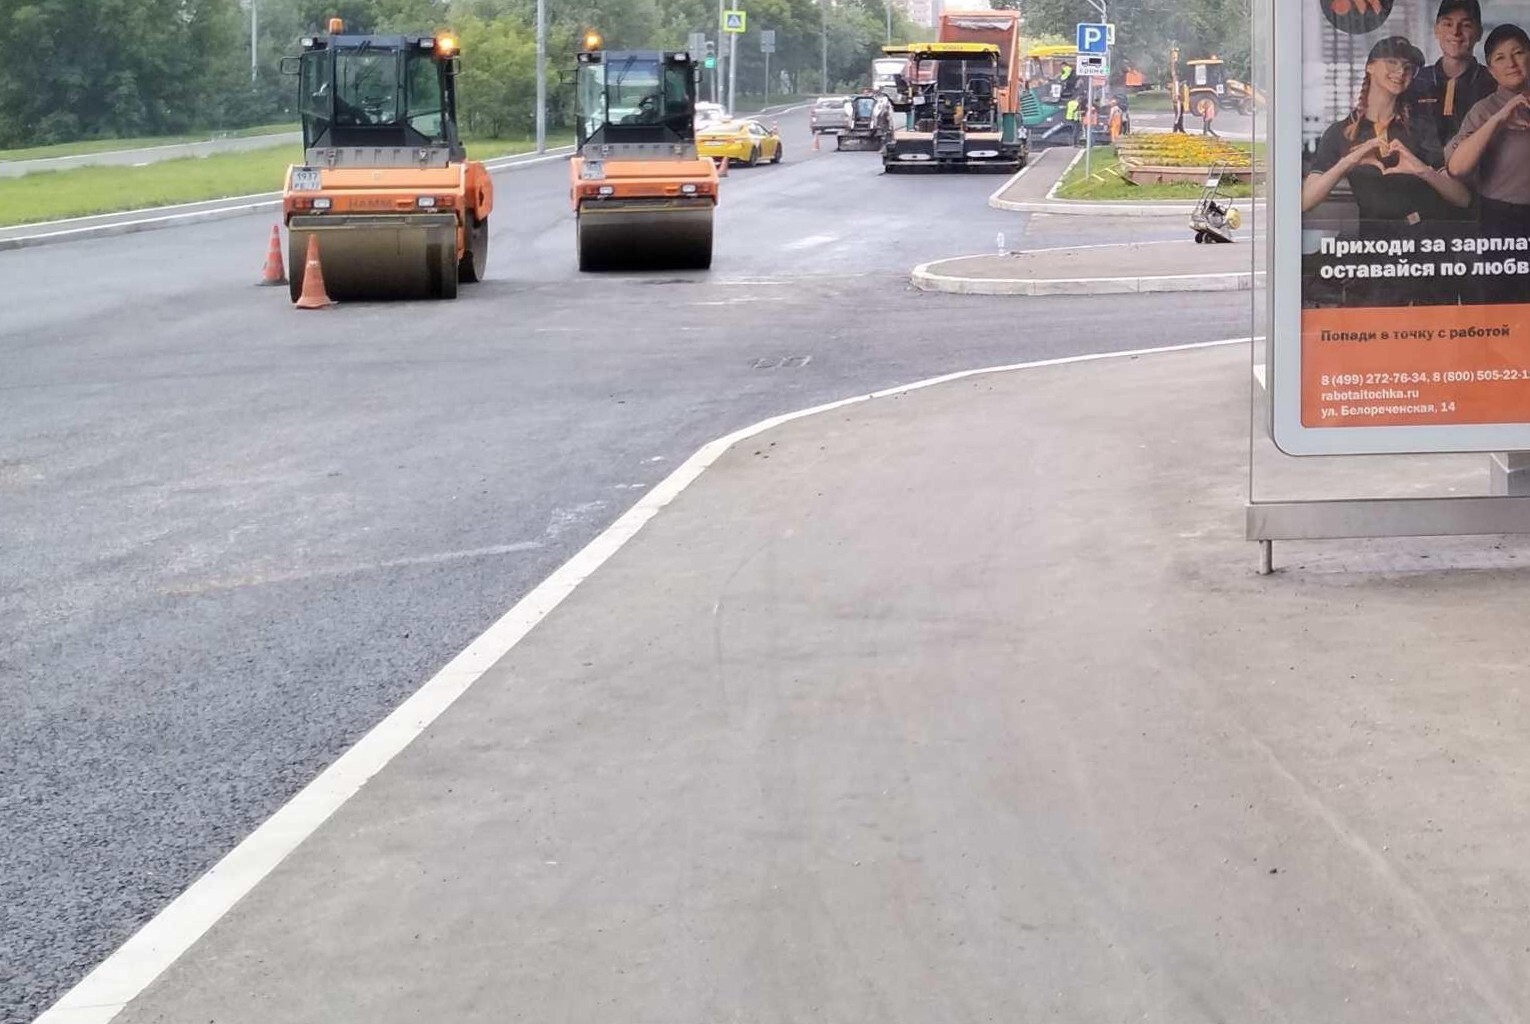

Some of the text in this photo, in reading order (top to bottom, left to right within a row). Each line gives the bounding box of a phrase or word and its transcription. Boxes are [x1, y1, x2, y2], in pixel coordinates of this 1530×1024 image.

[1320, 236, 1415, 257] Приходи
[1421, 238, 1446, 254] за
[1320, 259, 1435, 280] оставайся
[1440, 262, 1466, 277] по
[1321, 325, 1511, 343] Попади в точку с работой
[1321, 376, 1329, 386] 8
[1332, 374, 1363, 387] (499)
[1432, 372, 1440, 383] 8
[1443, 371, 1474, 384] (800)
[1321, 388, 1419, 401] rabotaitochka.ru
[1321, 401, 1456, 418] ул. Белореченская, 14
